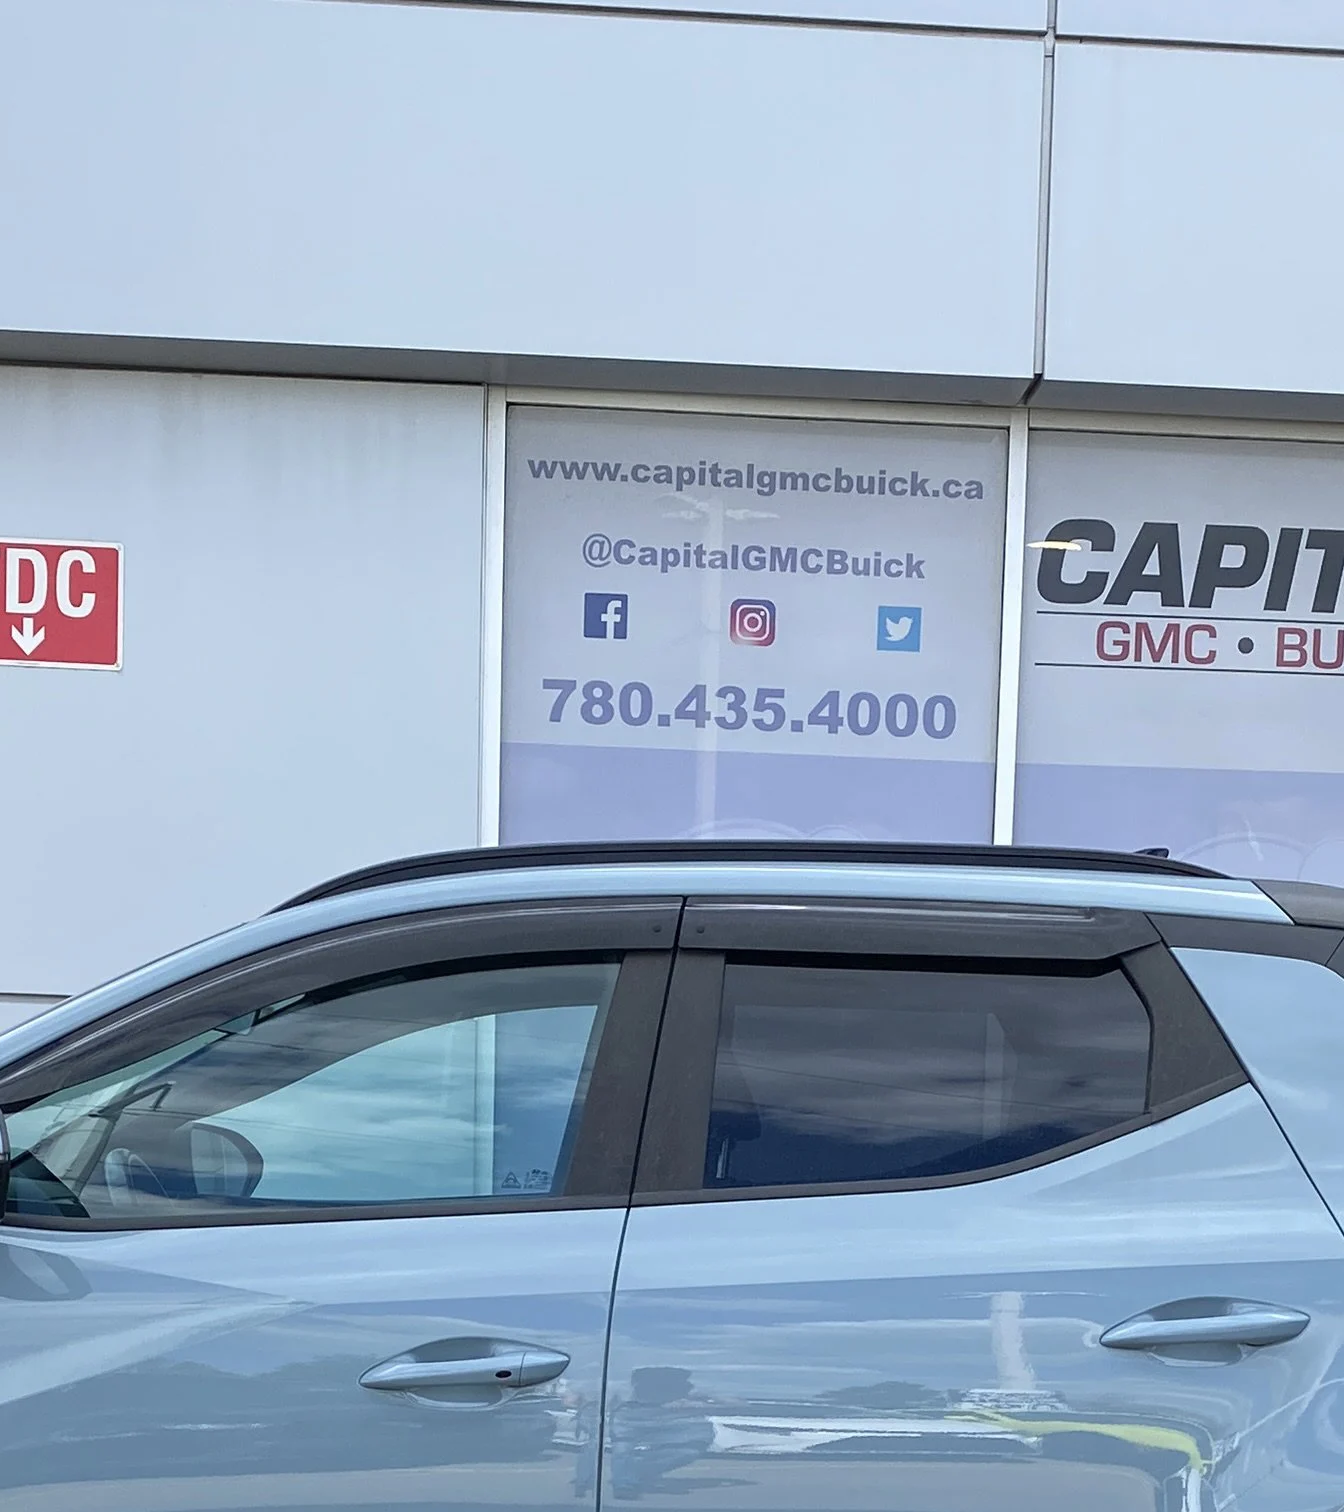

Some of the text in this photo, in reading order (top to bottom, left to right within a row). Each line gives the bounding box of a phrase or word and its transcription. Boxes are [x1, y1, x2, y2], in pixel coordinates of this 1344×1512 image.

[527, 458, 984, 500] www.capitalgmcbuick.ca
[582, 532, 926, 580] @CapitalGMCBuick
[1095, 620, 1217, 665] GMC
[541, 678, 957, 740] 780.435.4000
